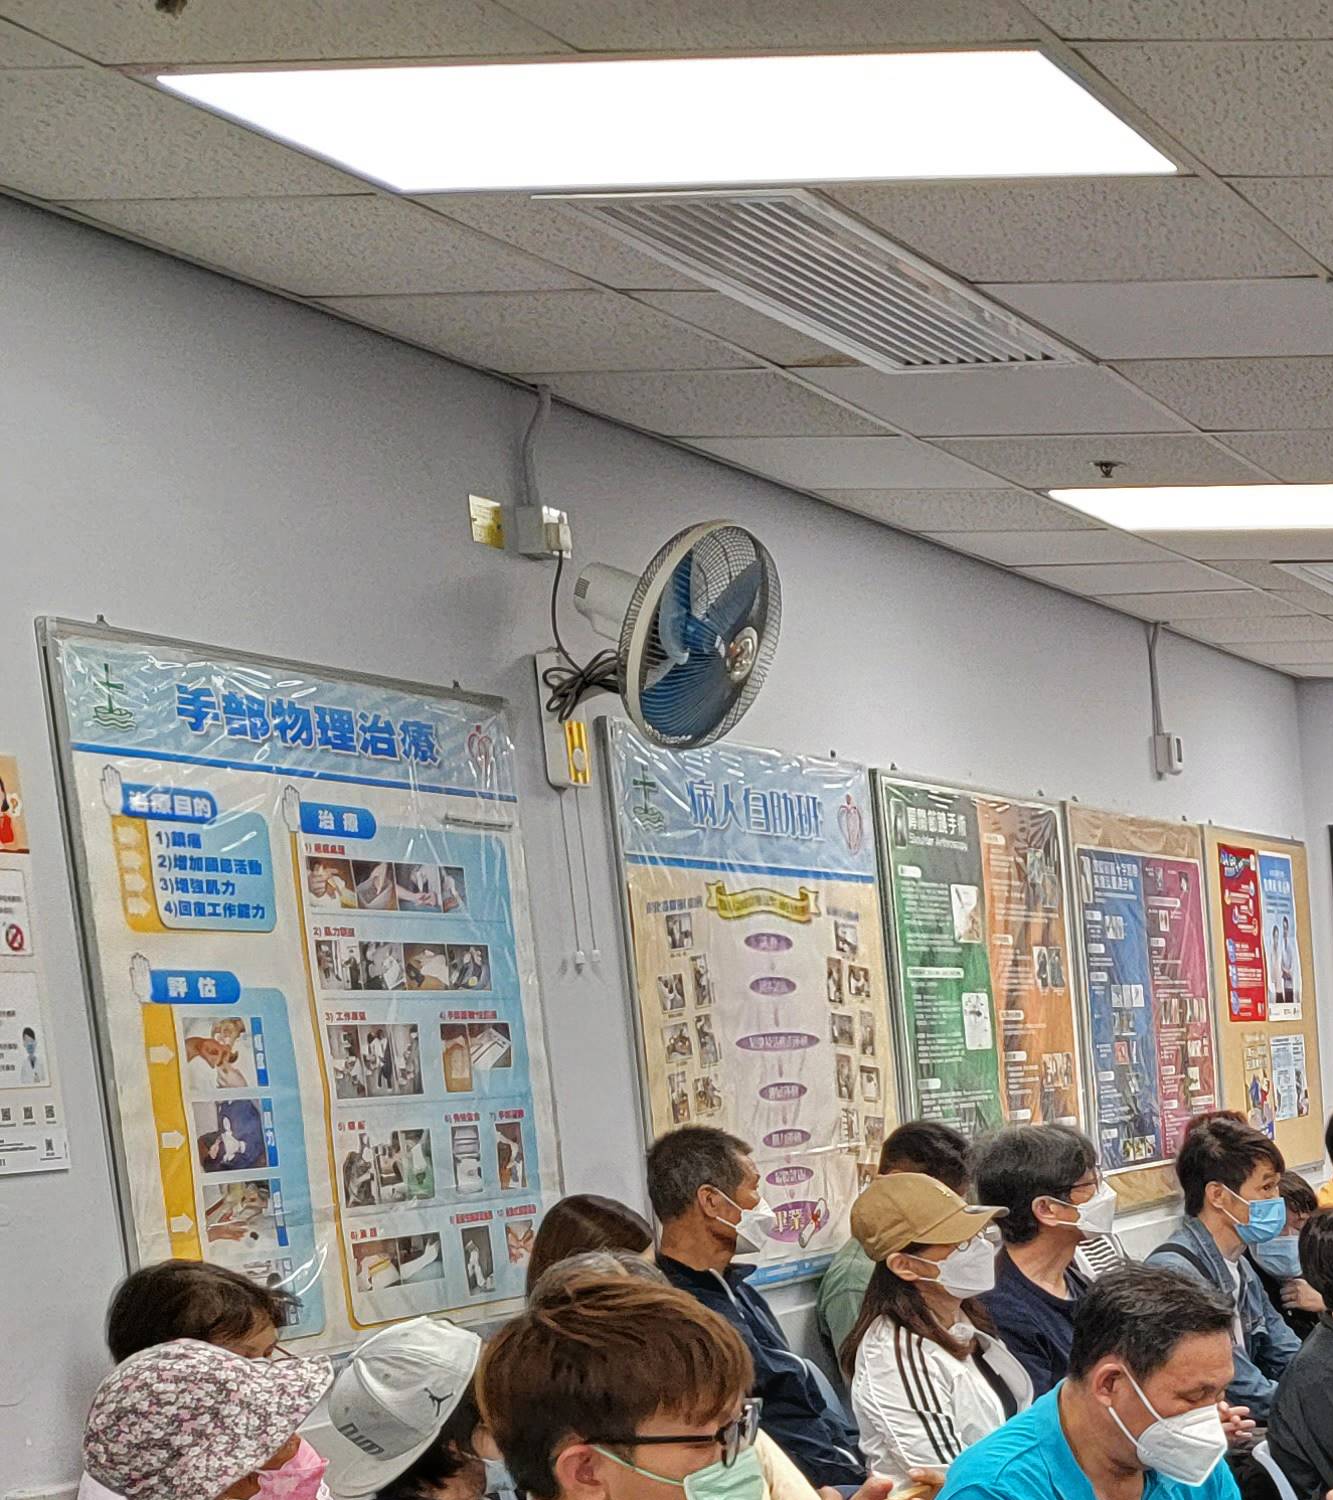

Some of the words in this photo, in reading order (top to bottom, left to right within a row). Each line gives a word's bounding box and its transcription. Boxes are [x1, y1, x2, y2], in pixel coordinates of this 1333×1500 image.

[176, 683, 440, 766] 手部物理治療
[317, 809, 359, 833] 治療
[686, 780, 824, 841] 病人自助班
